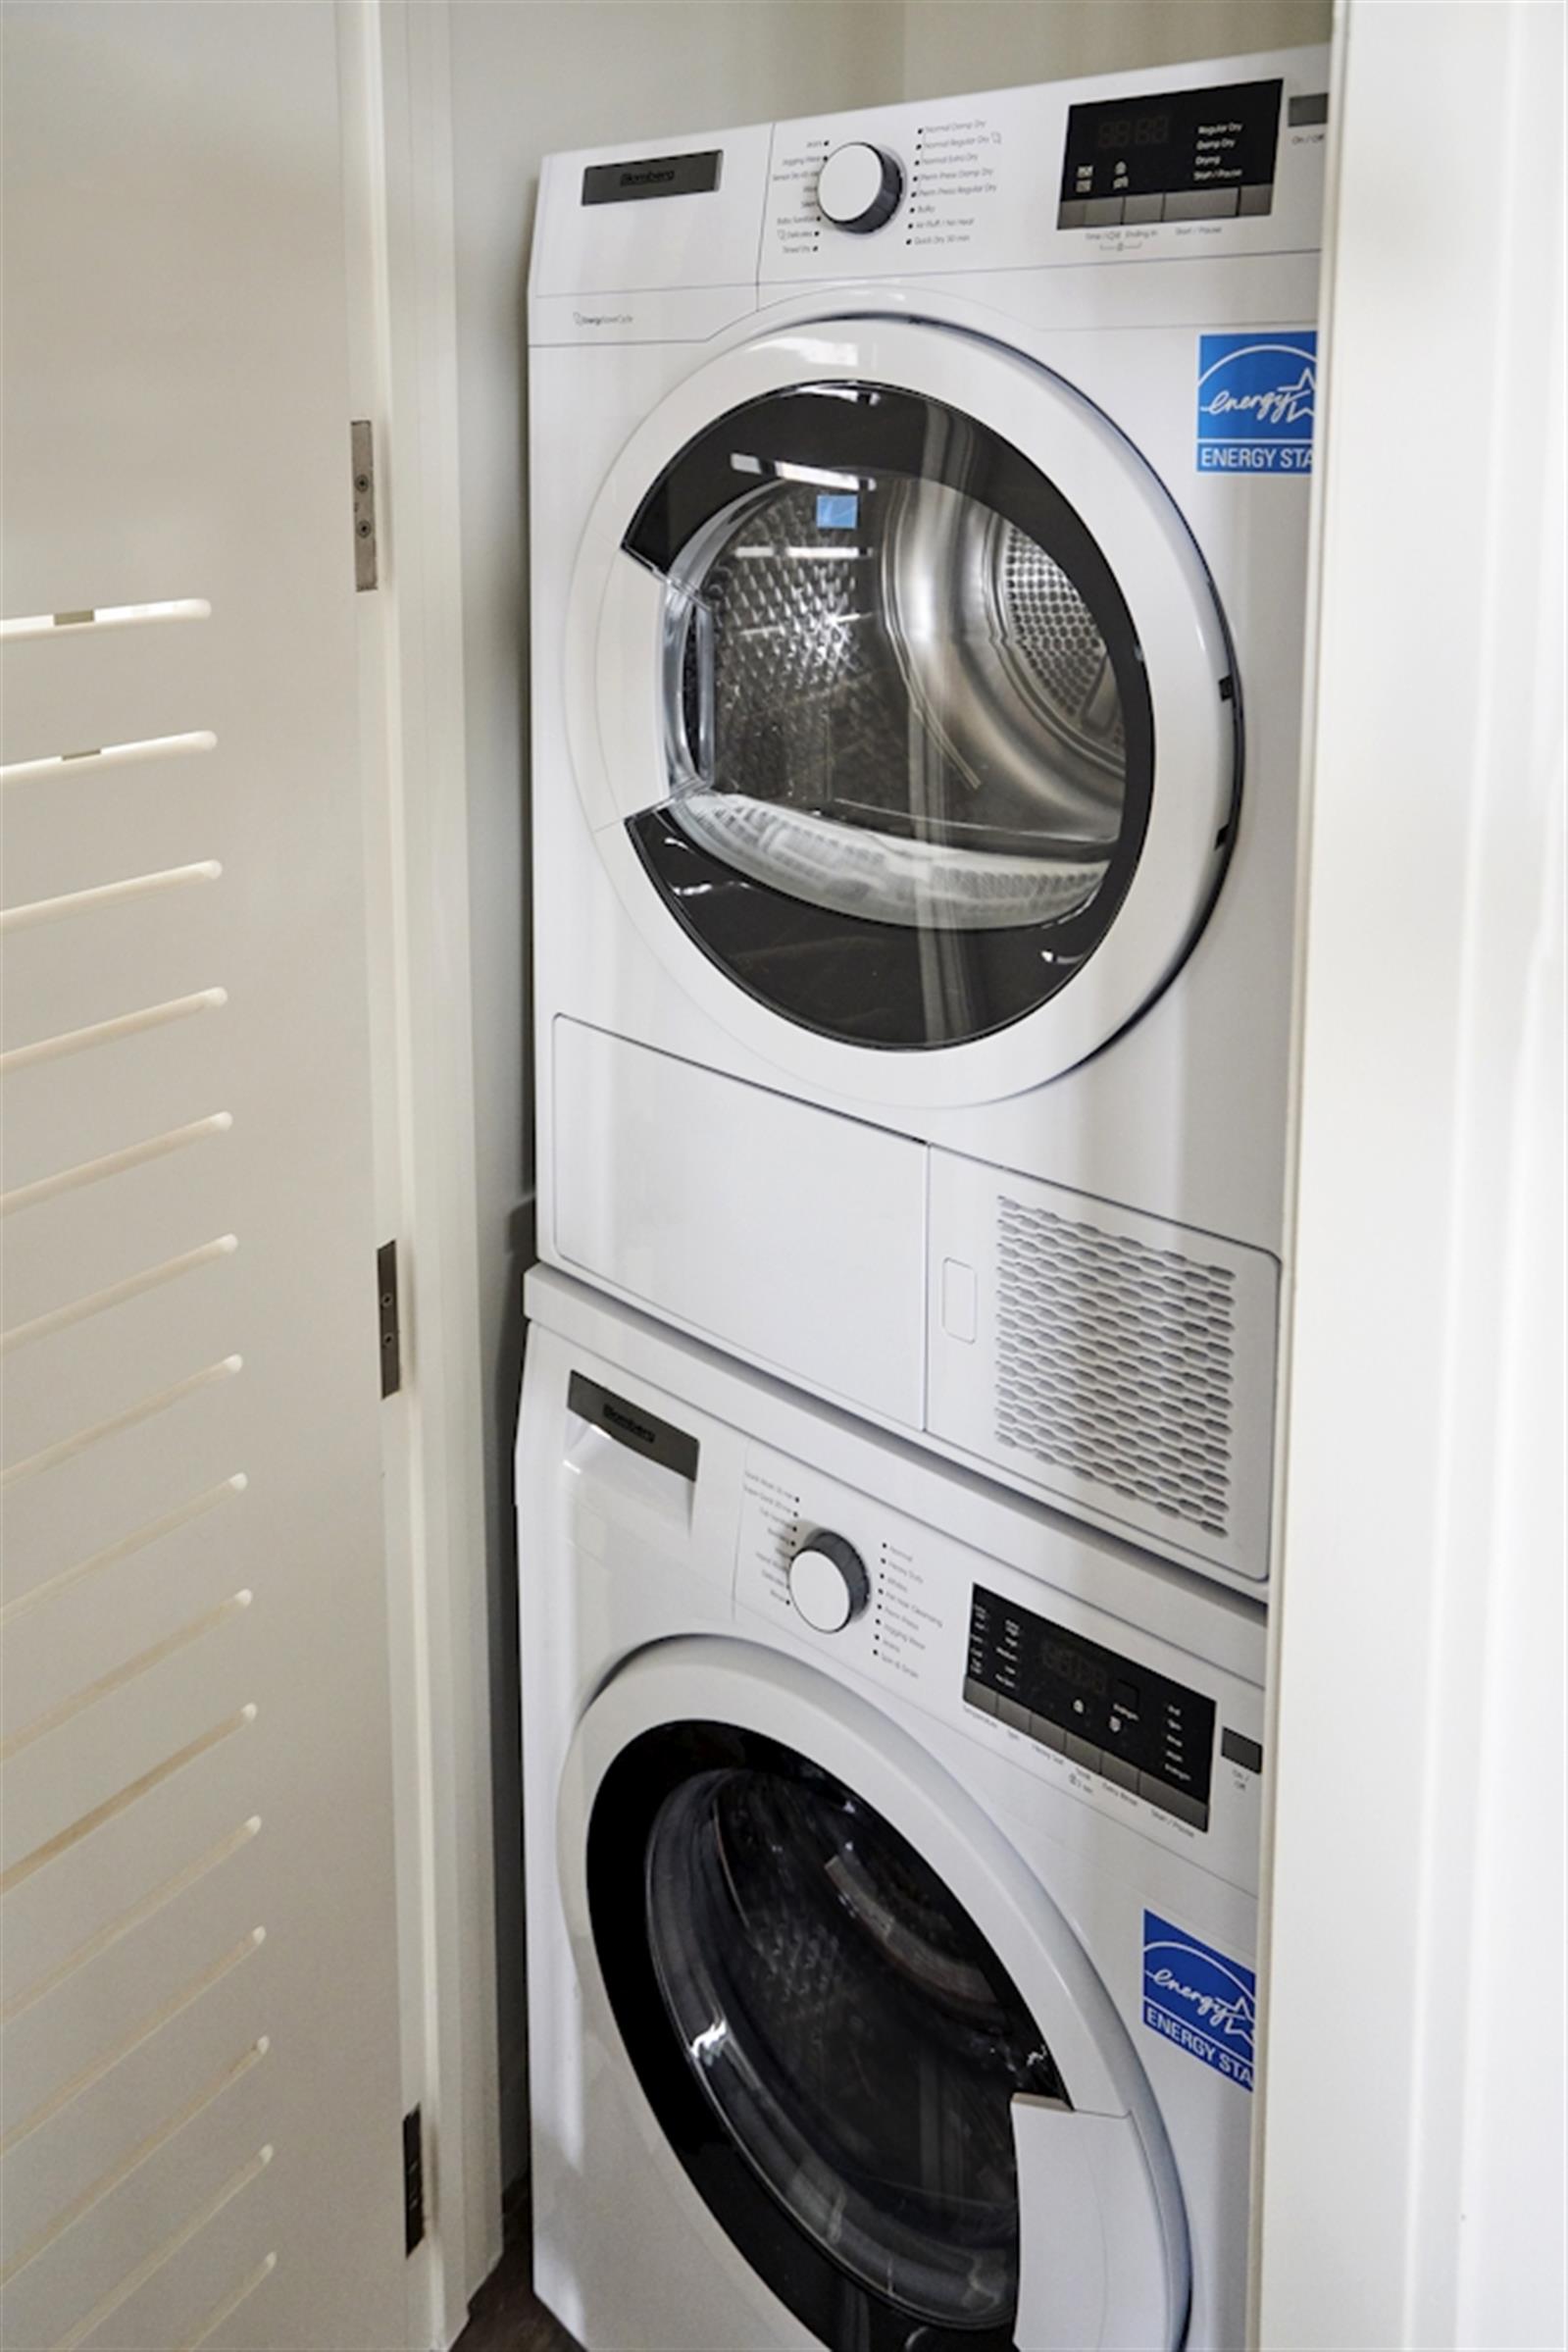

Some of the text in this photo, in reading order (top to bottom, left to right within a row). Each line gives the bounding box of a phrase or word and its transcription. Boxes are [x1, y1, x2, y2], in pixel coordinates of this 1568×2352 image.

[1200, 389, 1311, 424] energy
[1200, 447, 1313, 468] ENERGY STA
[1144, 1968, 1245, 2025] energy
[1146, 2006, 1254, 2083] ENERGY STA
